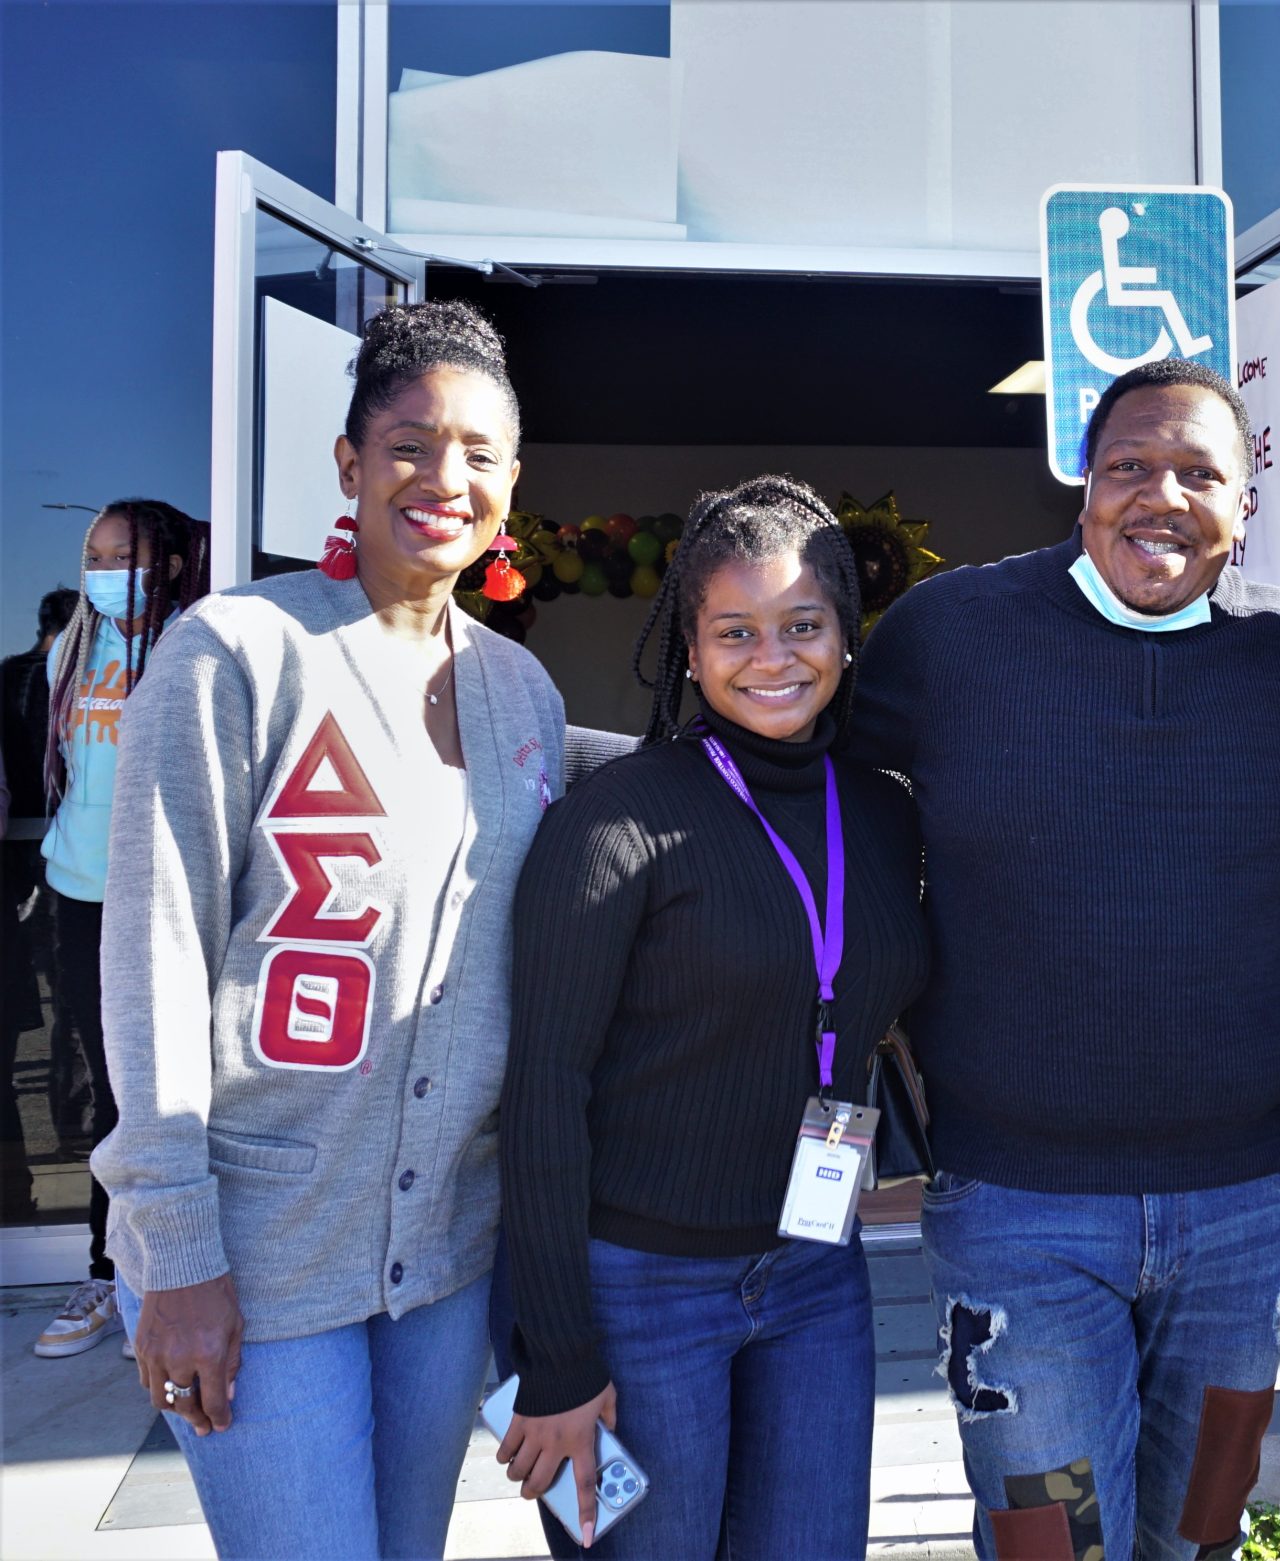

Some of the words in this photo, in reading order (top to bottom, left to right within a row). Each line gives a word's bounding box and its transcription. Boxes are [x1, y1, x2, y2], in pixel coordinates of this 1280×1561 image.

[1237, 357, 1267, 388] LCOME
[1252, 425, 1273, 476] HE
[818, 1168, 841, 1180] HID
